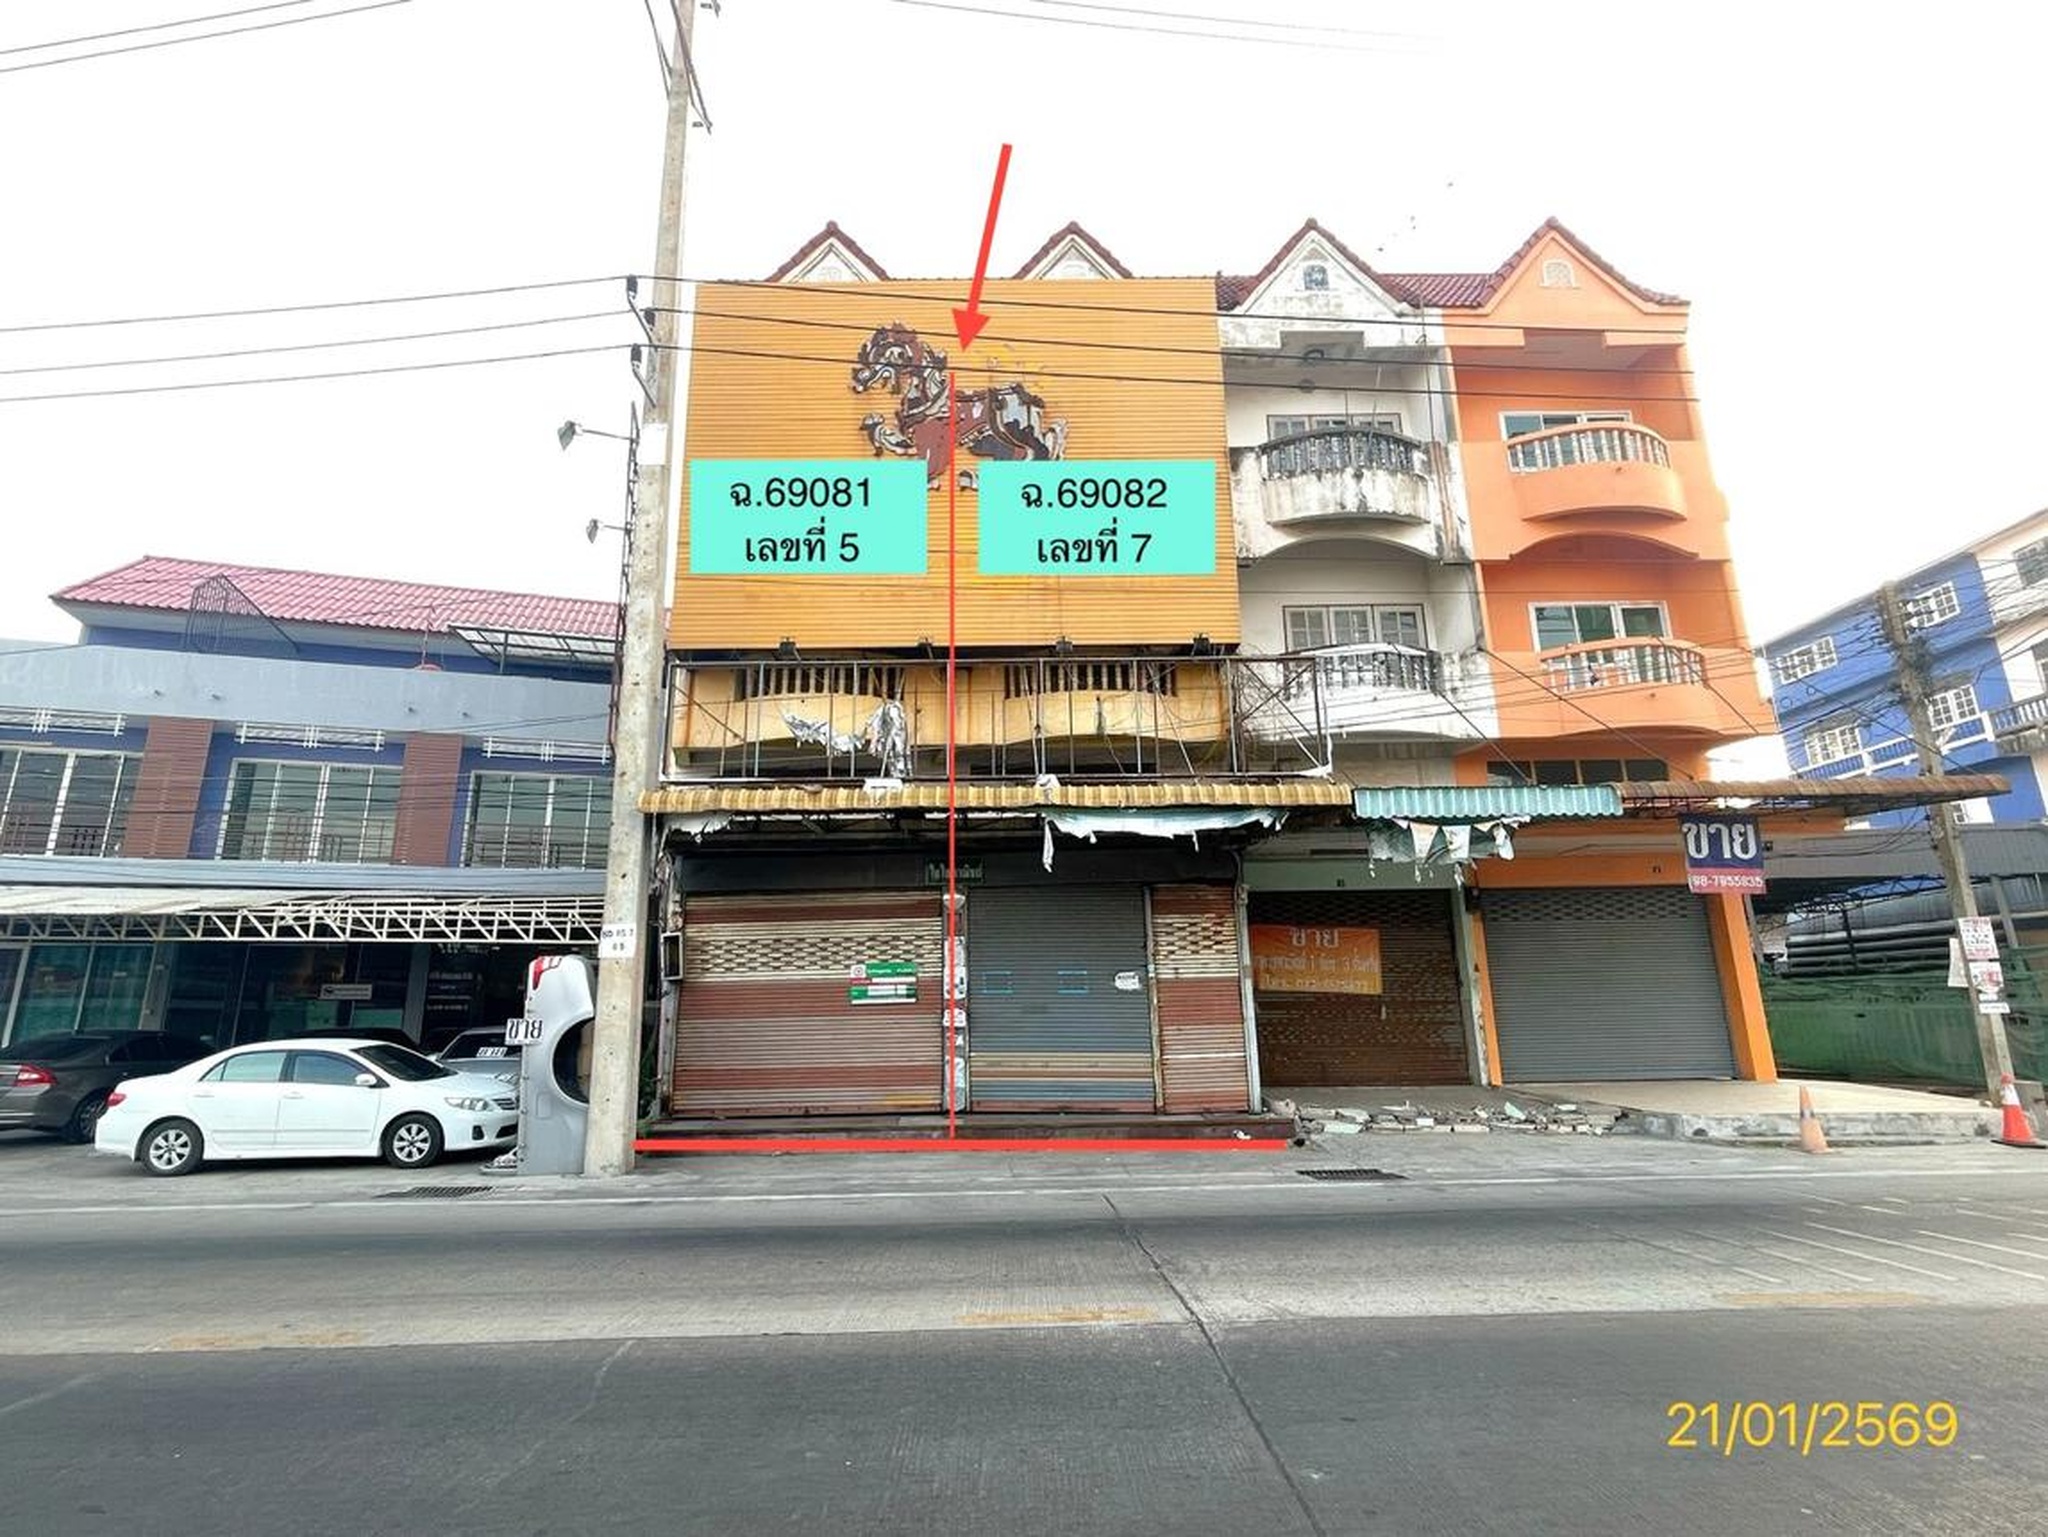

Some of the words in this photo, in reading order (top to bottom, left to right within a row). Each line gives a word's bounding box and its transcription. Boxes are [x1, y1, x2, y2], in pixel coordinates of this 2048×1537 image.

[1682, 823, 1757, 859] ขาย
[1289, 928, 1340, 948] ขาย
[509, 1020, 543, 1039] ขาย
